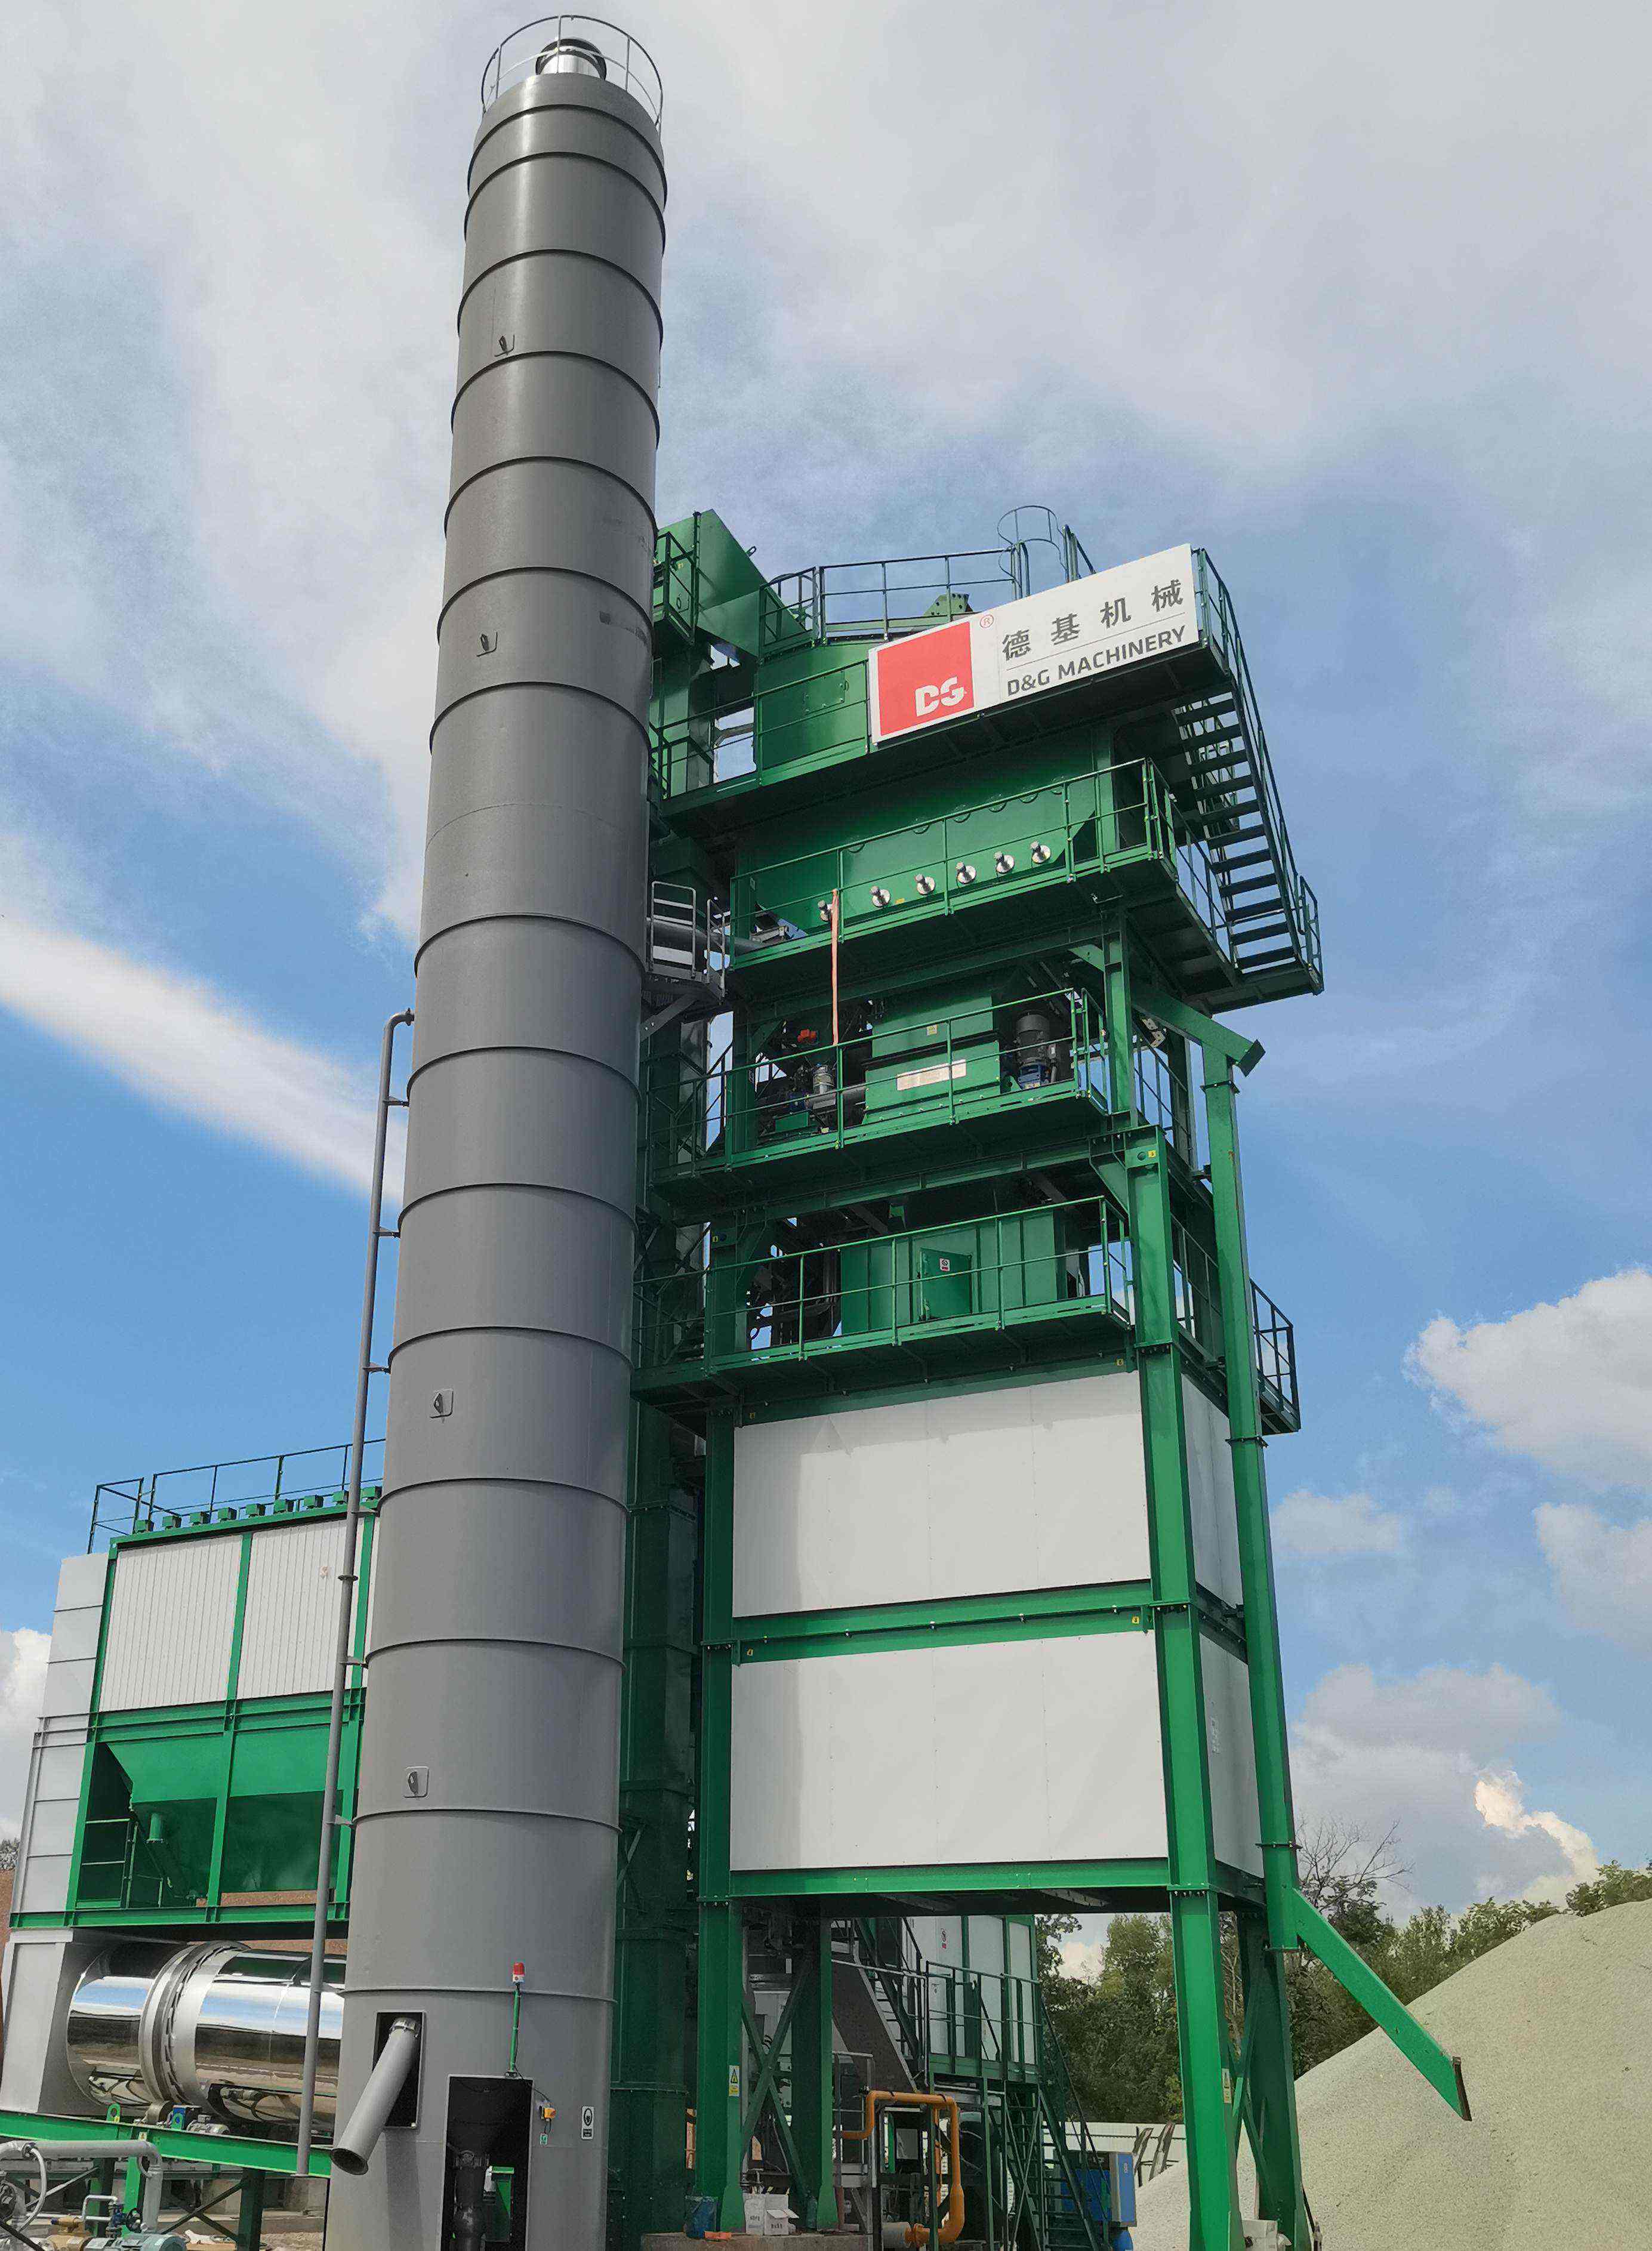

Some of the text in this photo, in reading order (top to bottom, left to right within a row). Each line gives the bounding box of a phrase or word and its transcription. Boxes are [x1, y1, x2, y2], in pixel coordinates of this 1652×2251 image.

[1002, 579, 1183, 661] 德基机械
[1007, 625, 1186, 696] D&G MACHINERY
